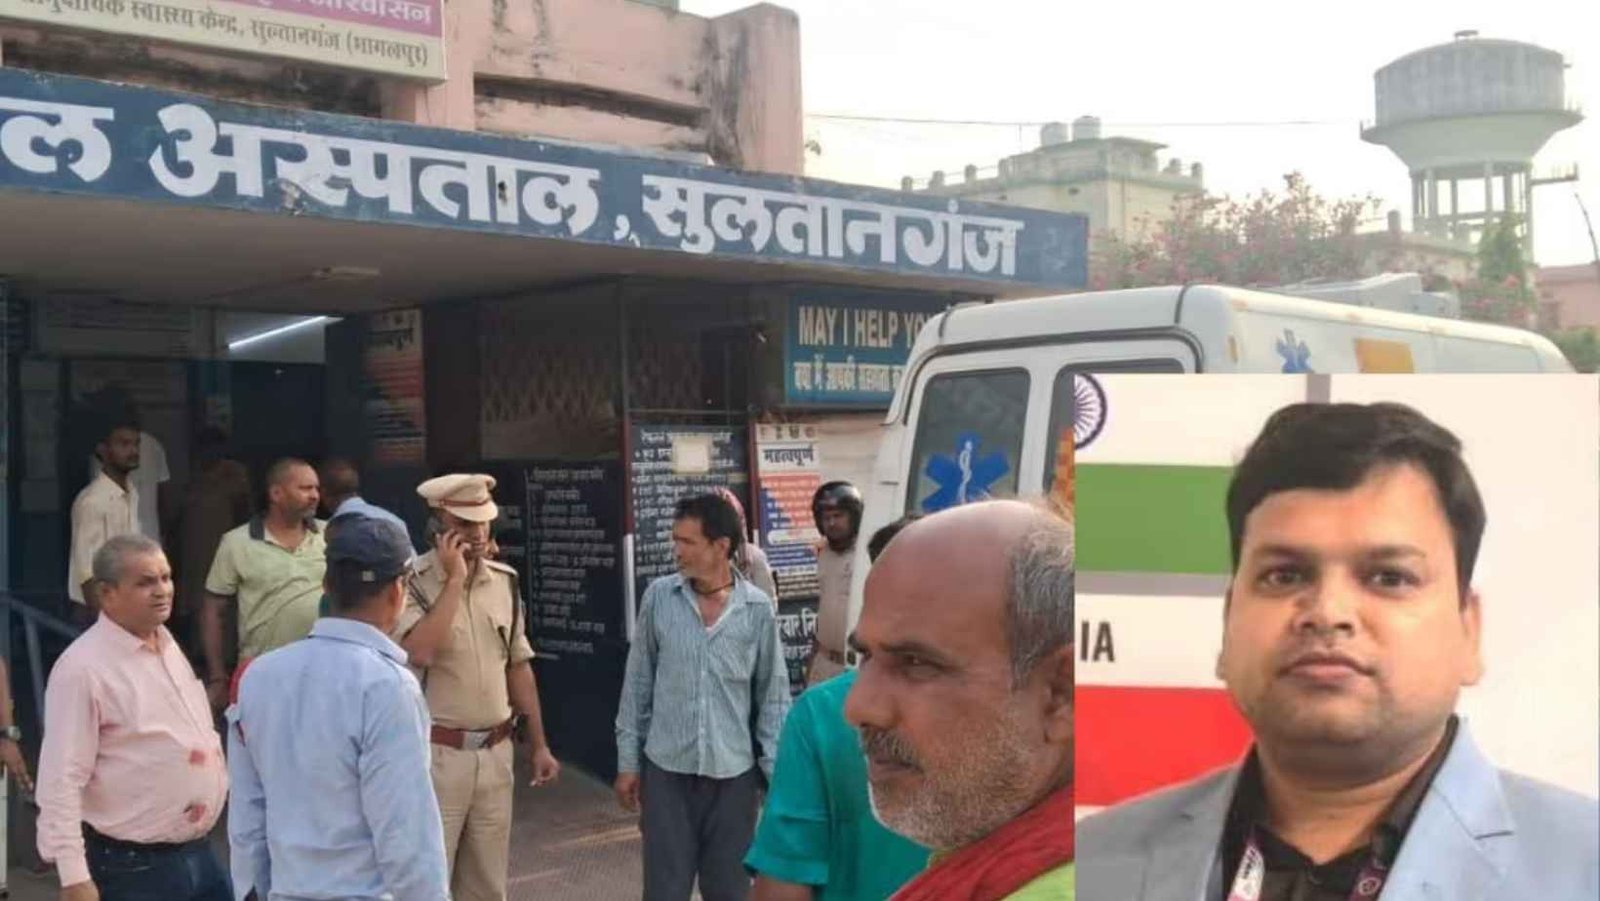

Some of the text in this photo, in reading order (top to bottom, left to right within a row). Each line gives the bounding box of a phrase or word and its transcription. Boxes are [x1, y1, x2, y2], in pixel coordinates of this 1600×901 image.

[642, 172, 1025, 276] सुलतानगंज
[799, 306, 837, 345] MAY
[843, 308, 849, 346] I
[854, 309, 899, 348] HELP
[1081, 620, 1115, 662] IA
